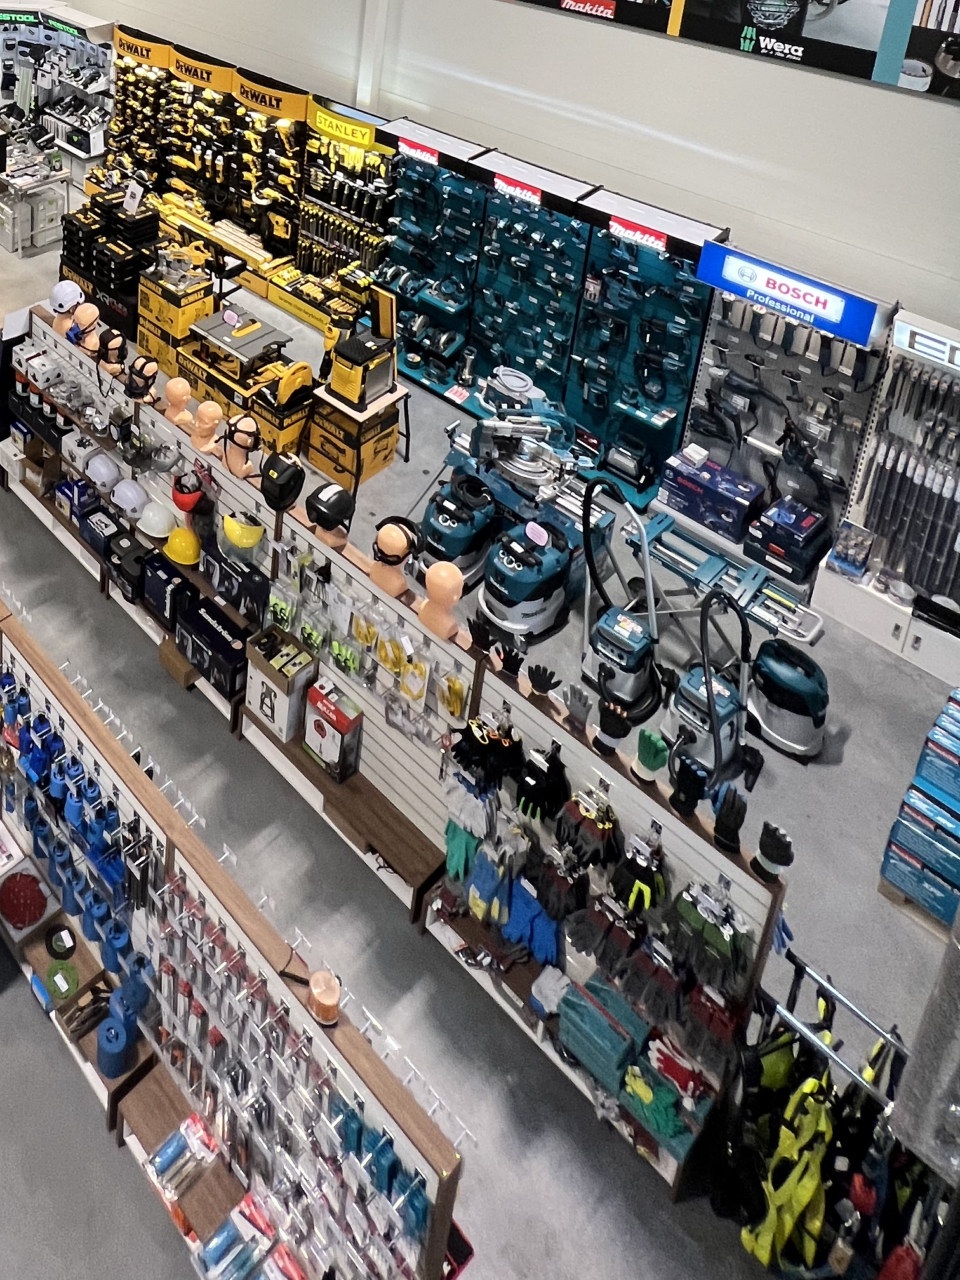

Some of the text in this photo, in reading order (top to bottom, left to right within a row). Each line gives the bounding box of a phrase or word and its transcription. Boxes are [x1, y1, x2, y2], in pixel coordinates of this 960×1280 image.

[48, 19, 82, 37] FESTOOL
[759, 36, 805, 57] Wera
[317, 114, 368, 141] STANLEY
[746, 289, 815, 323] Professional
[765, 277, 828, 310] BOSCH
